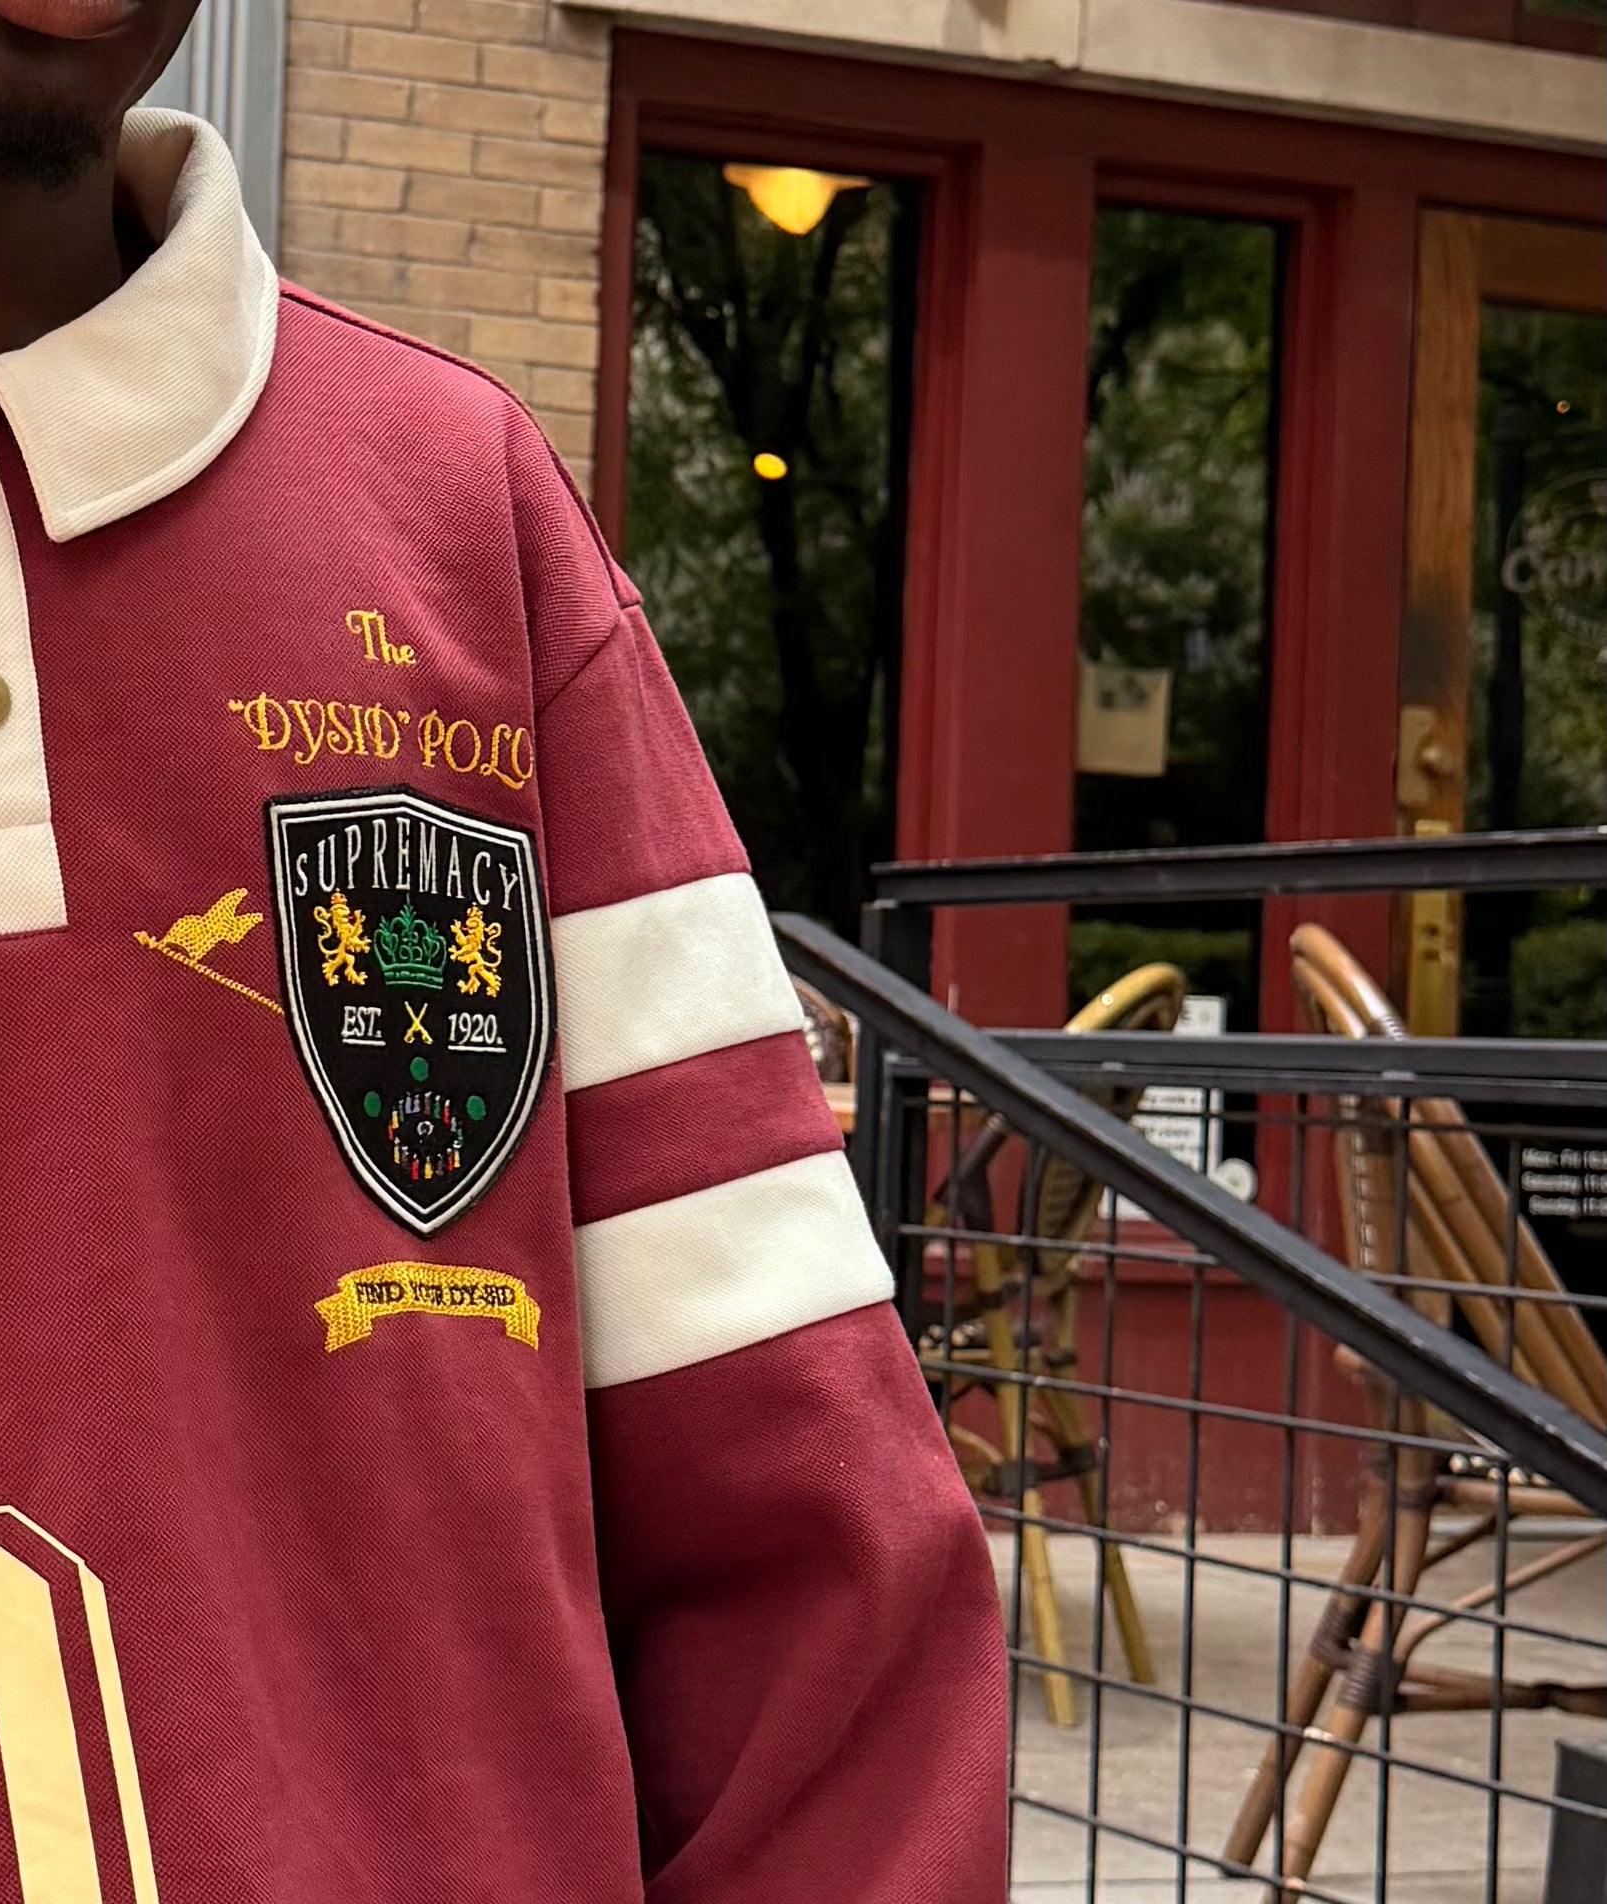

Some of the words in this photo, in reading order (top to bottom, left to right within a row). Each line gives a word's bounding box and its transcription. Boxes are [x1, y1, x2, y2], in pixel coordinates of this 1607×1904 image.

[345, 607, 417, 666] The
[417, 709, 534, 790] POLO
[295, 816, 519, 911] SUPREMACY
[341, 1005, 383, 1039] EST.
[447, 1011, 504, 1046] 1920.
